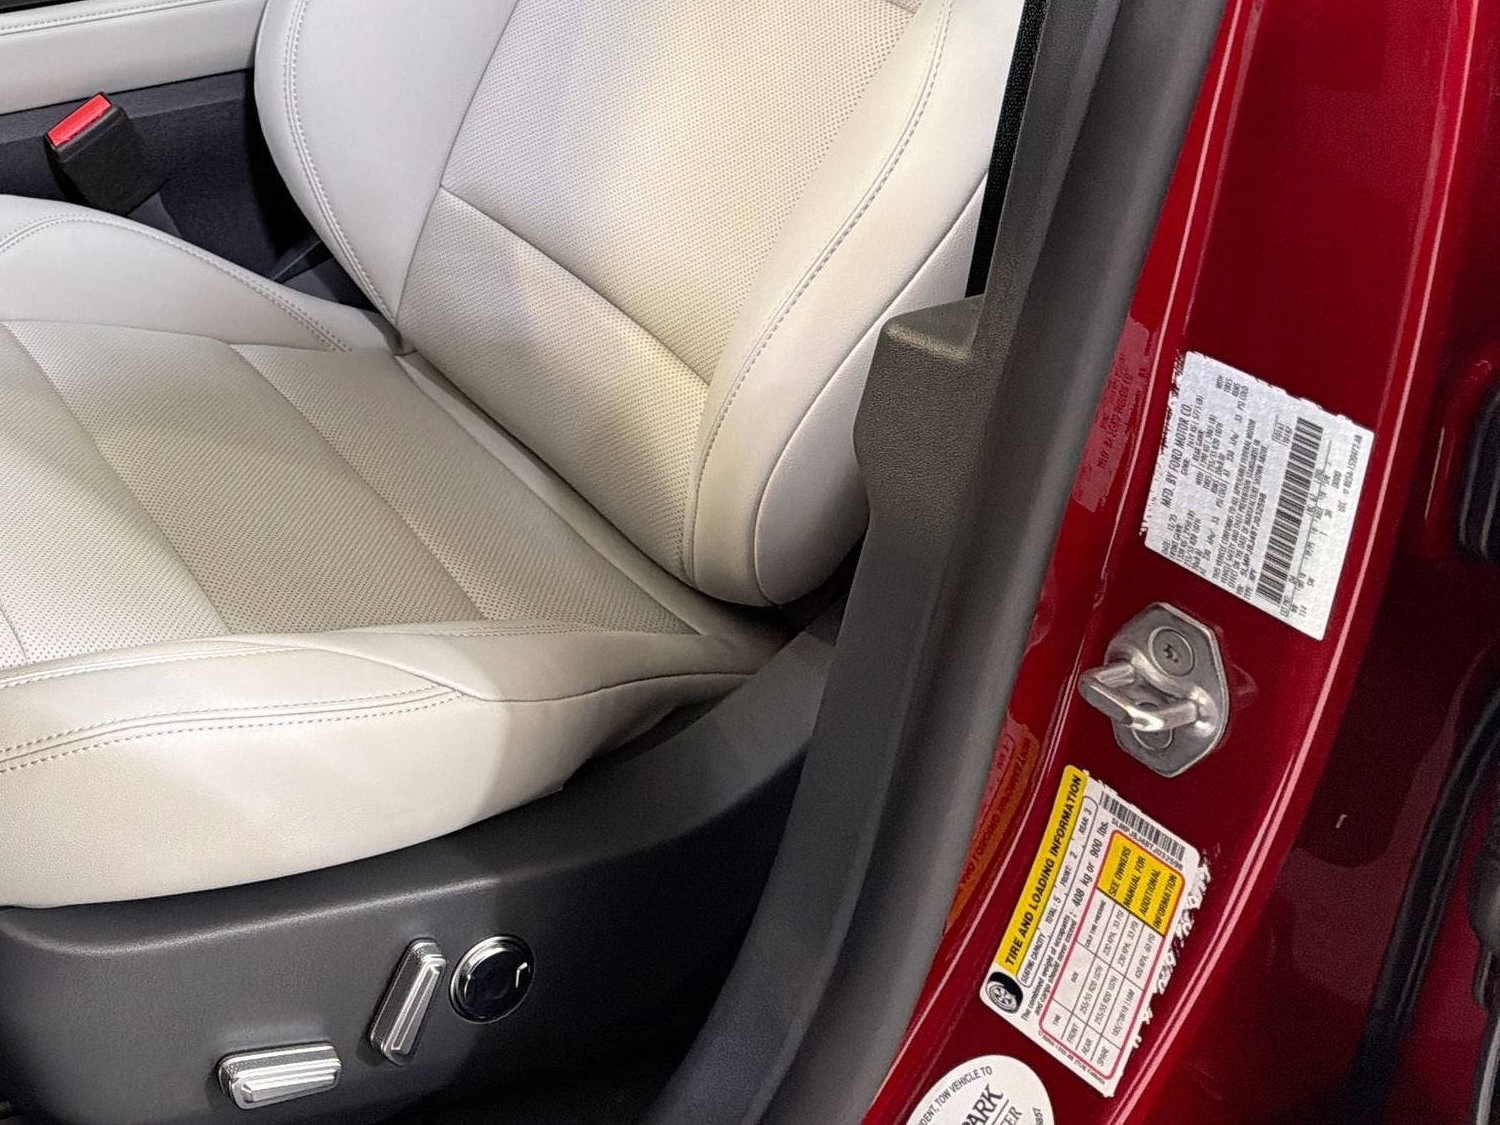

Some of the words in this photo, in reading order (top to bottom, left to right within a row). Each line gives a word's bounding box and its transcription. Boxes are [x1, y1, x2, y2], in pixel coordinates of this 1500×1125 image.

[1175, 417, 1189, 448] MOTOR
[1180, 404, 1192, 417] CO.
[1165, 471, 1177, 485] BY
[1168, 448, 1182, 472] FORD
[1005, 937, 1023, 965] TIRE
[1019, 912, 1033, 937] AND
[1029, 858, 1054, 910] LOADING
[1050, 775, 1080, 856] INFORMATION
[1072, 888, 1084, 906] 408
[1080, 873, 1092, 886] kg
[1086, 861, 1094, 873] or
[1090, 838, 1102, 858] 900
[1108, 880, 1119, 896] SEE
[1115, 846, 1131, 880] OWNERS
[1123, 875, 1140, 907] MANUAL
[1135, 856, 1145, 873] FOR
[1139, 870, 1160, 915] ADDITIONAL
[1153, 874, 1176, 928] INFORMATION
[1021, 960, 1034, 983] SEATING
[1031, 933, 1045, 960] CAPACITY
[1021, 1009, 1031, 1021] The
[1028, 977, 1044, 1008] combined
[1042, 955, 1053, 977] weight
[1051, 946, 1057, 955] of
[1054, 915, 1070, 947] occupants
[1035, 1001, 1043, 1015] and
[1040, 984, 1051, 1002] cargo
[1048, 961, 1060, 983] should
[1057, 943, 1067, 962] never
[1067, 1023, 1078, 1043] FRONT
[1082, 1038, 1092, 1054] REAR
[1097, 1047, 1109, 1066] SPARE
[935, 1089, 952, 1107] TOW
[949, 1069, 981, 1094] VEHICLE
[980, 1065, 993, 1076] TO
